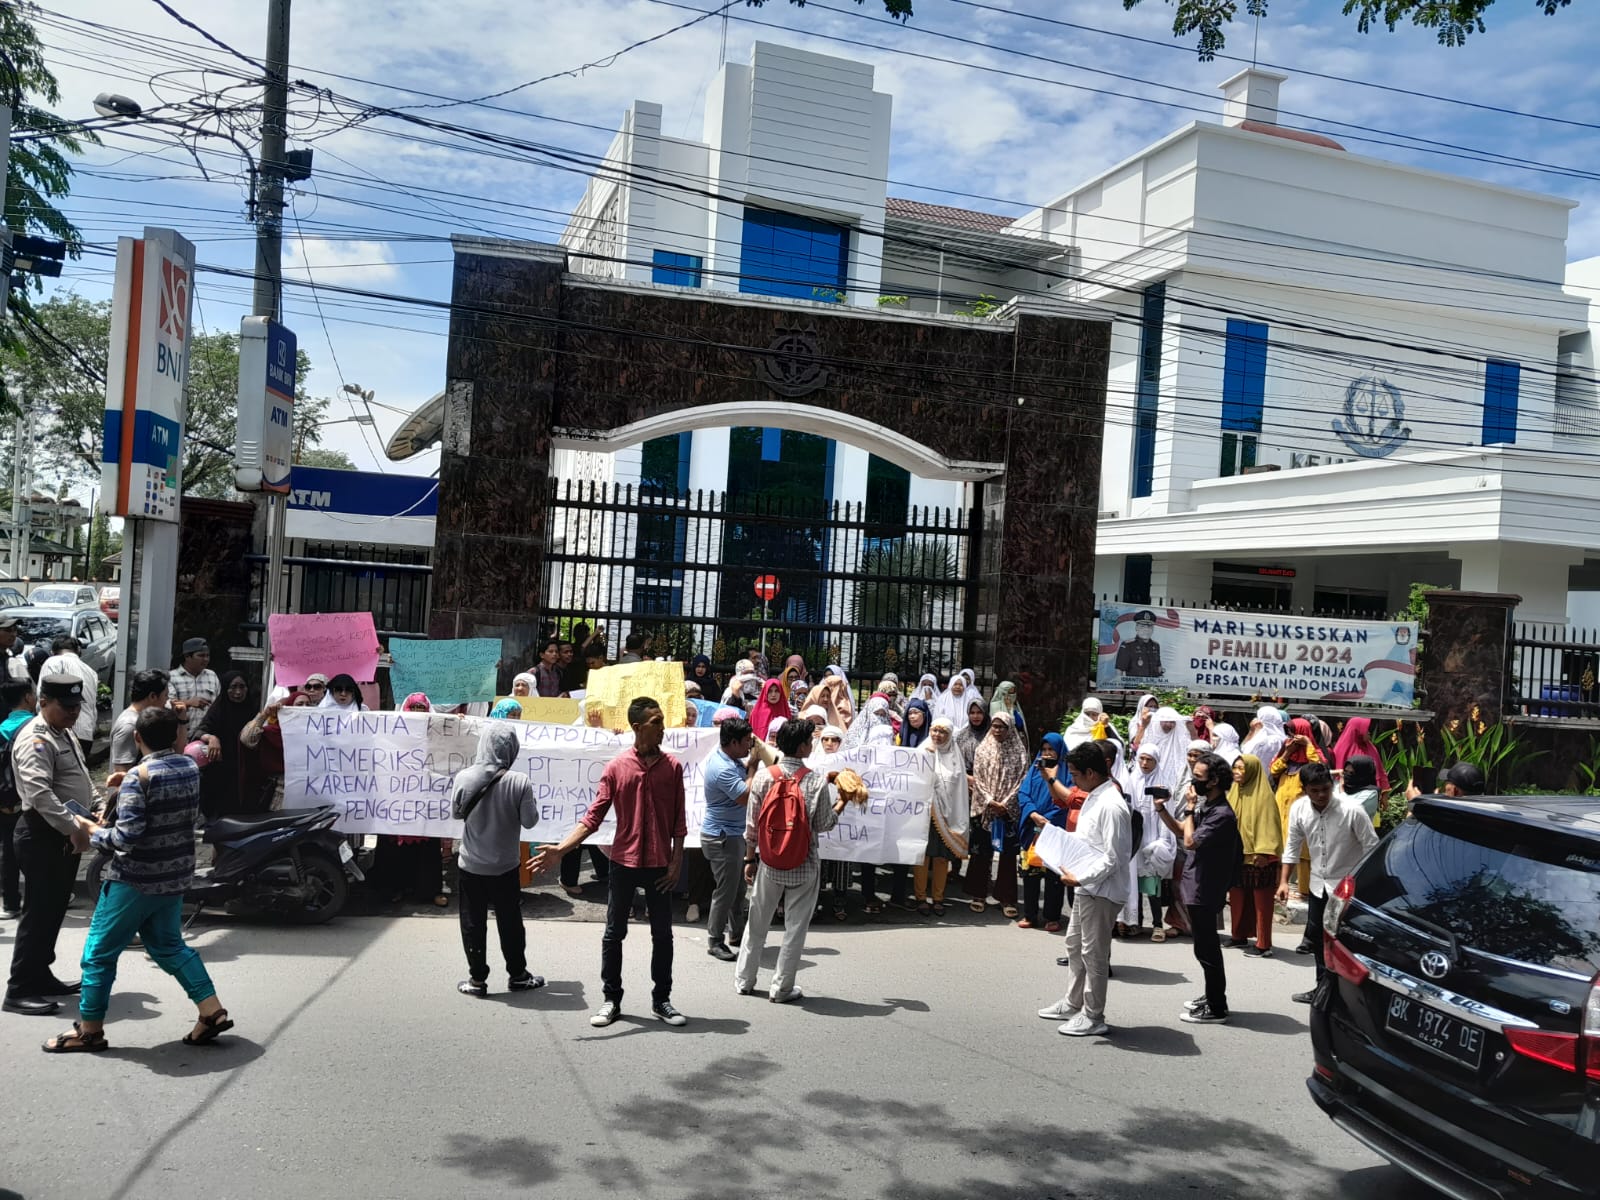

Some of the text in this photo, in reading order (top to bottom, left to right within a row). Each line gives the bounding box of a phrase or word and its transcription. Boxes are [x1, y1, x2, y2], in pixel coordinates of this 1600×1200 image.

[157, 342, 182, 383] BNI
[269, 362, 284, 383] BANK
[270, 405, 288, 429] ATM
[151, 424, 169, 447] ATM
[287, 489, 331, 507] ATM
[1193, 618, 1368, 644] MARI SUKSESKAN
[1207, 638, 1353, 665] PEMILU 2024
[1190, 658, 1366, 680] DENGAN TETAP MENJAGA
[1196, 673, 1279, 689] PERSATUAN
[1284, 678, 1360, 694] INDONESIA
[305, 714, 410, 737] MEMINTA
[524, 724, 623, 748] KAPOLDA
[305, 744, 434, 773] MEMERIKSA
[894, 749, 936, 773] DAN
[304, 775, 379, 796] KARENA
[861, 771, 914, 793] SAWIT
[1390, 997, 1480, 1053] BK 1874 DE
